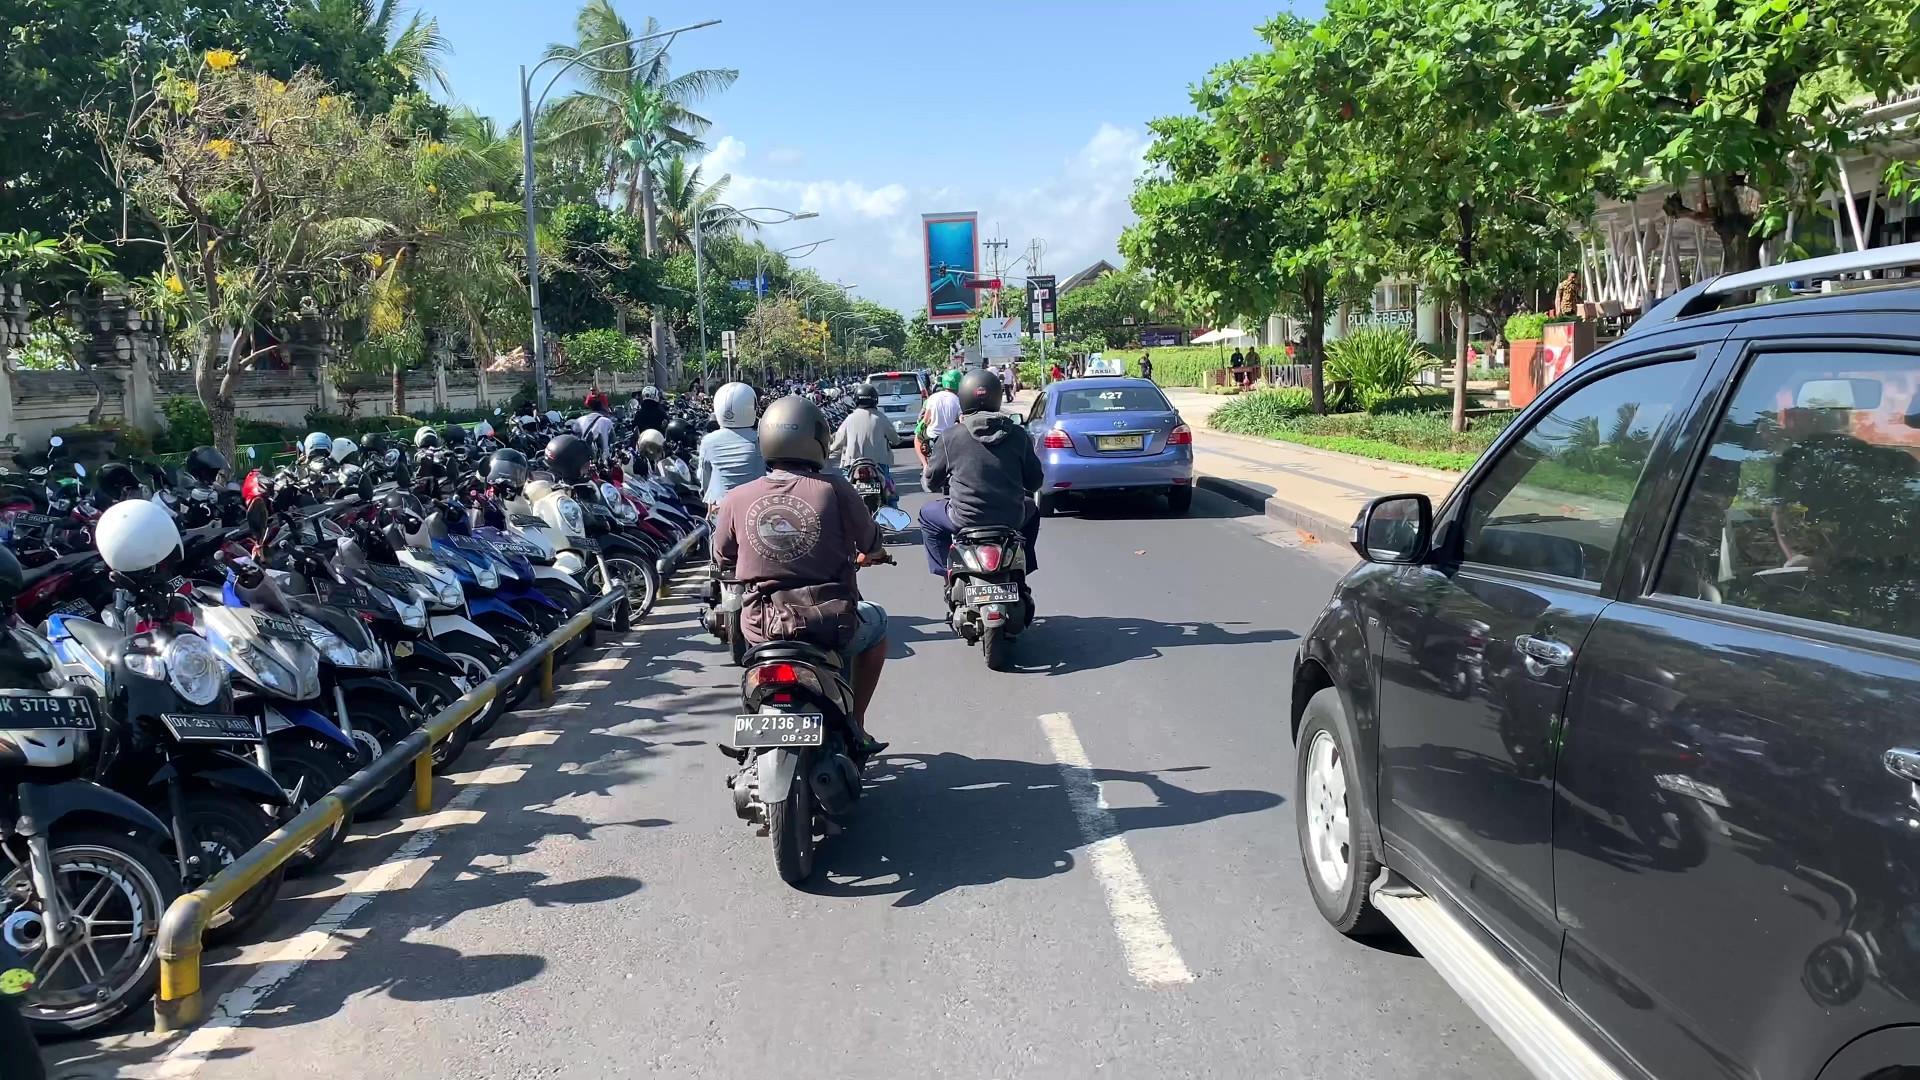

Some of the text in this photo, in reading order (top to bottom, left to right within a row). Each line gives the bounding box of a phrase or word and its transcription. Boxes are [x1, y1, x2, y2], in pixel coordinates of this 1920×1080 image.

[1098, 391, 1123, 400] 427
[967, 587, 977, 596] DK
[20, 698, 60, 712] 5779
[171, 717, 191, 728] DK
[737, 715, 820, 732] DK 2136 BT
